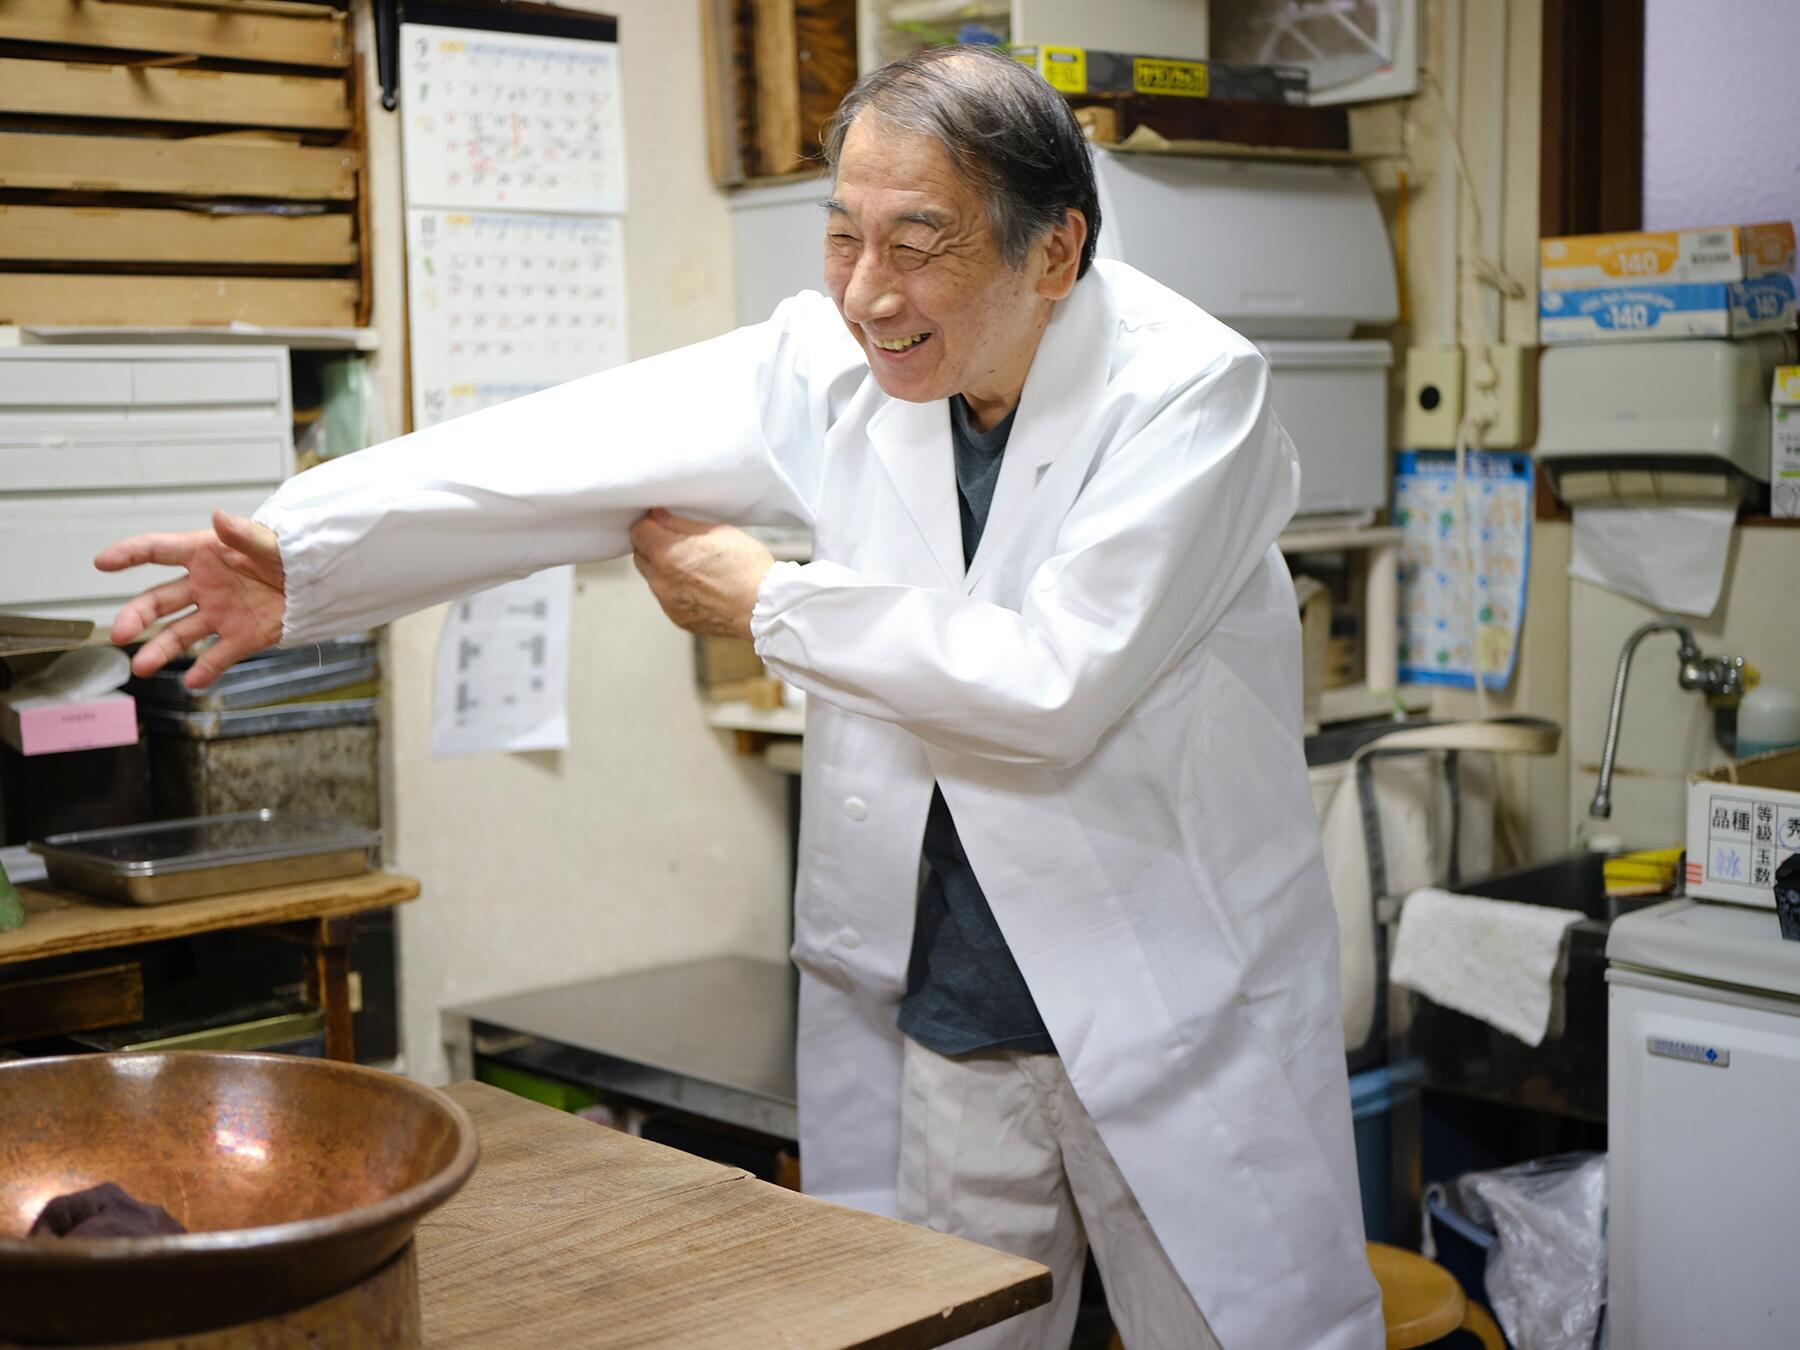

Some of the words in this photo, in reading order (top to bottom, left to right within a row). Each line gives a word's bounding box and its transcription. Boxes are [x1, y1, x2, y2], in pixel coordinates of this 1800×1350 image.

[1619, 251, 1658, 275] 140
[1611, 303, 1648, 328] 140
[1712, 808, 1750, 832] 品種
[1756, 806, 1773, 842] 等級
[1754, 849, 1772, 885] 玉数
